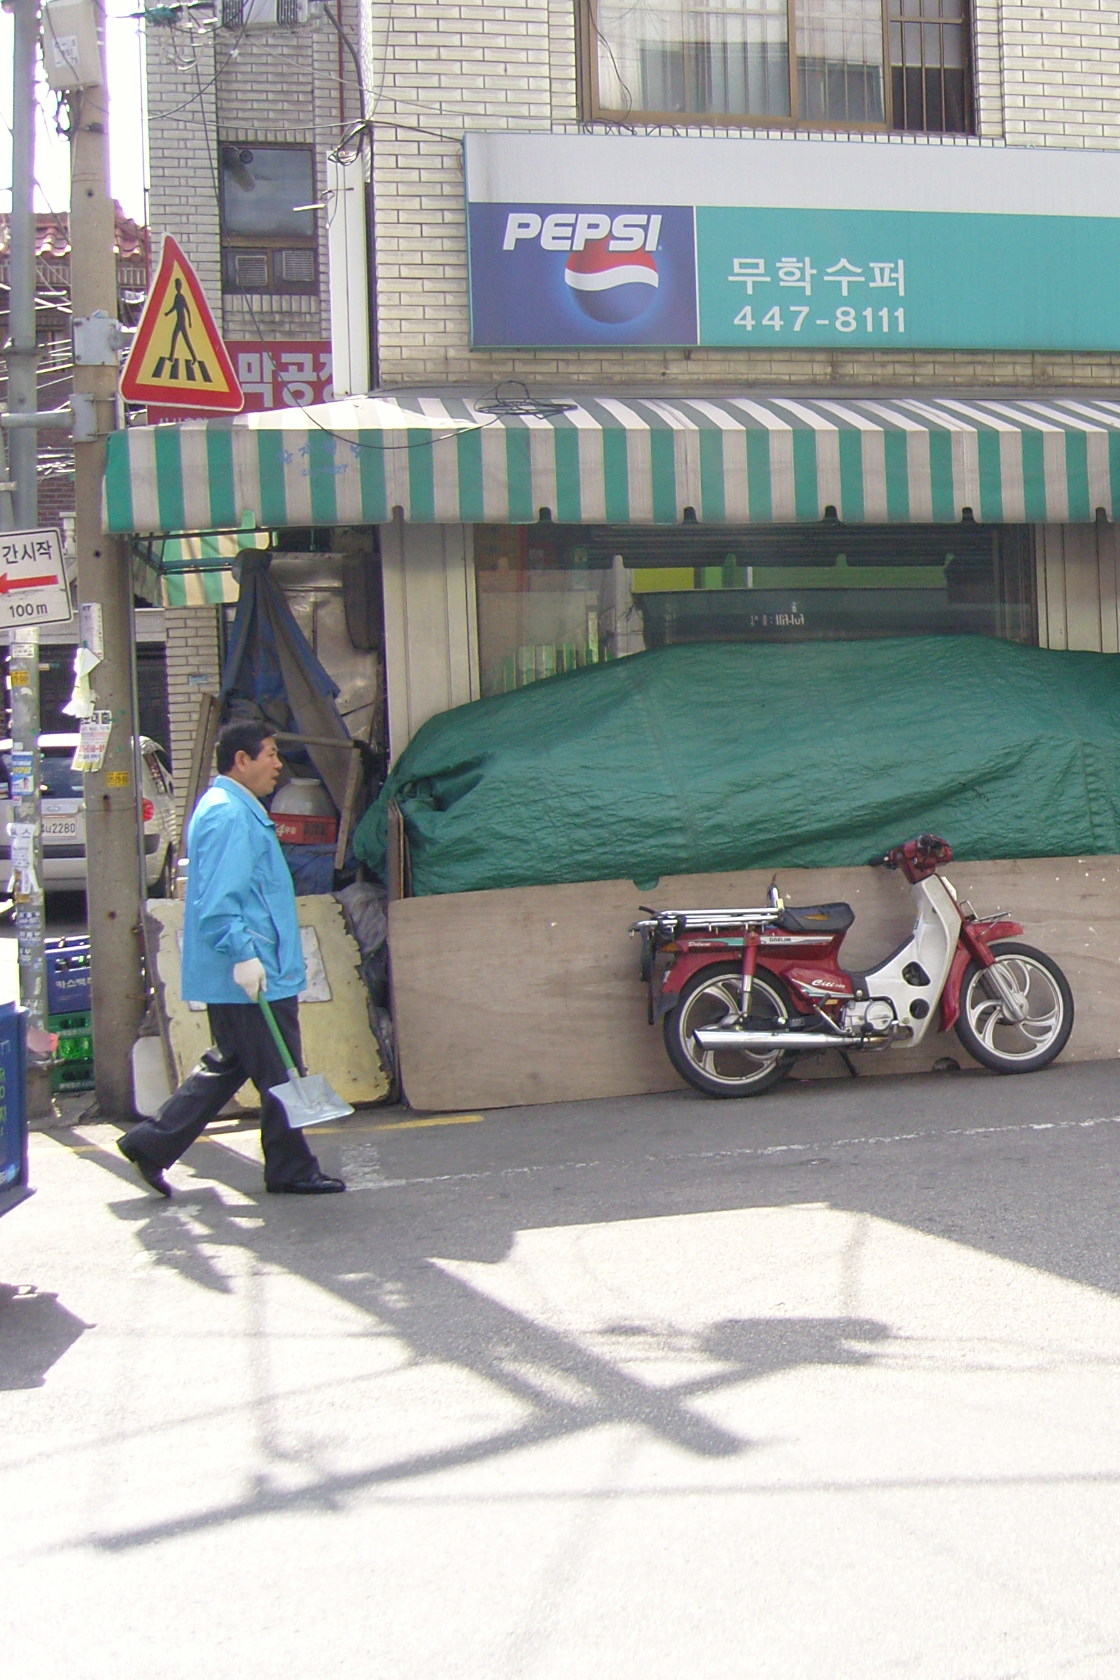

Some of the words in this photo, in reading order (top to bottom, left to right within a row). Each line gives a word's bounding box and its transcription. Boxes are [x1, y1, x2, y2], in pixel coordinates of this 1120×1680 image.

[503, 213, 662, 251] PEPSI
[727, 256, 905, 297] 무학수퍼
[733, 305, 905, 333] 447-8111
